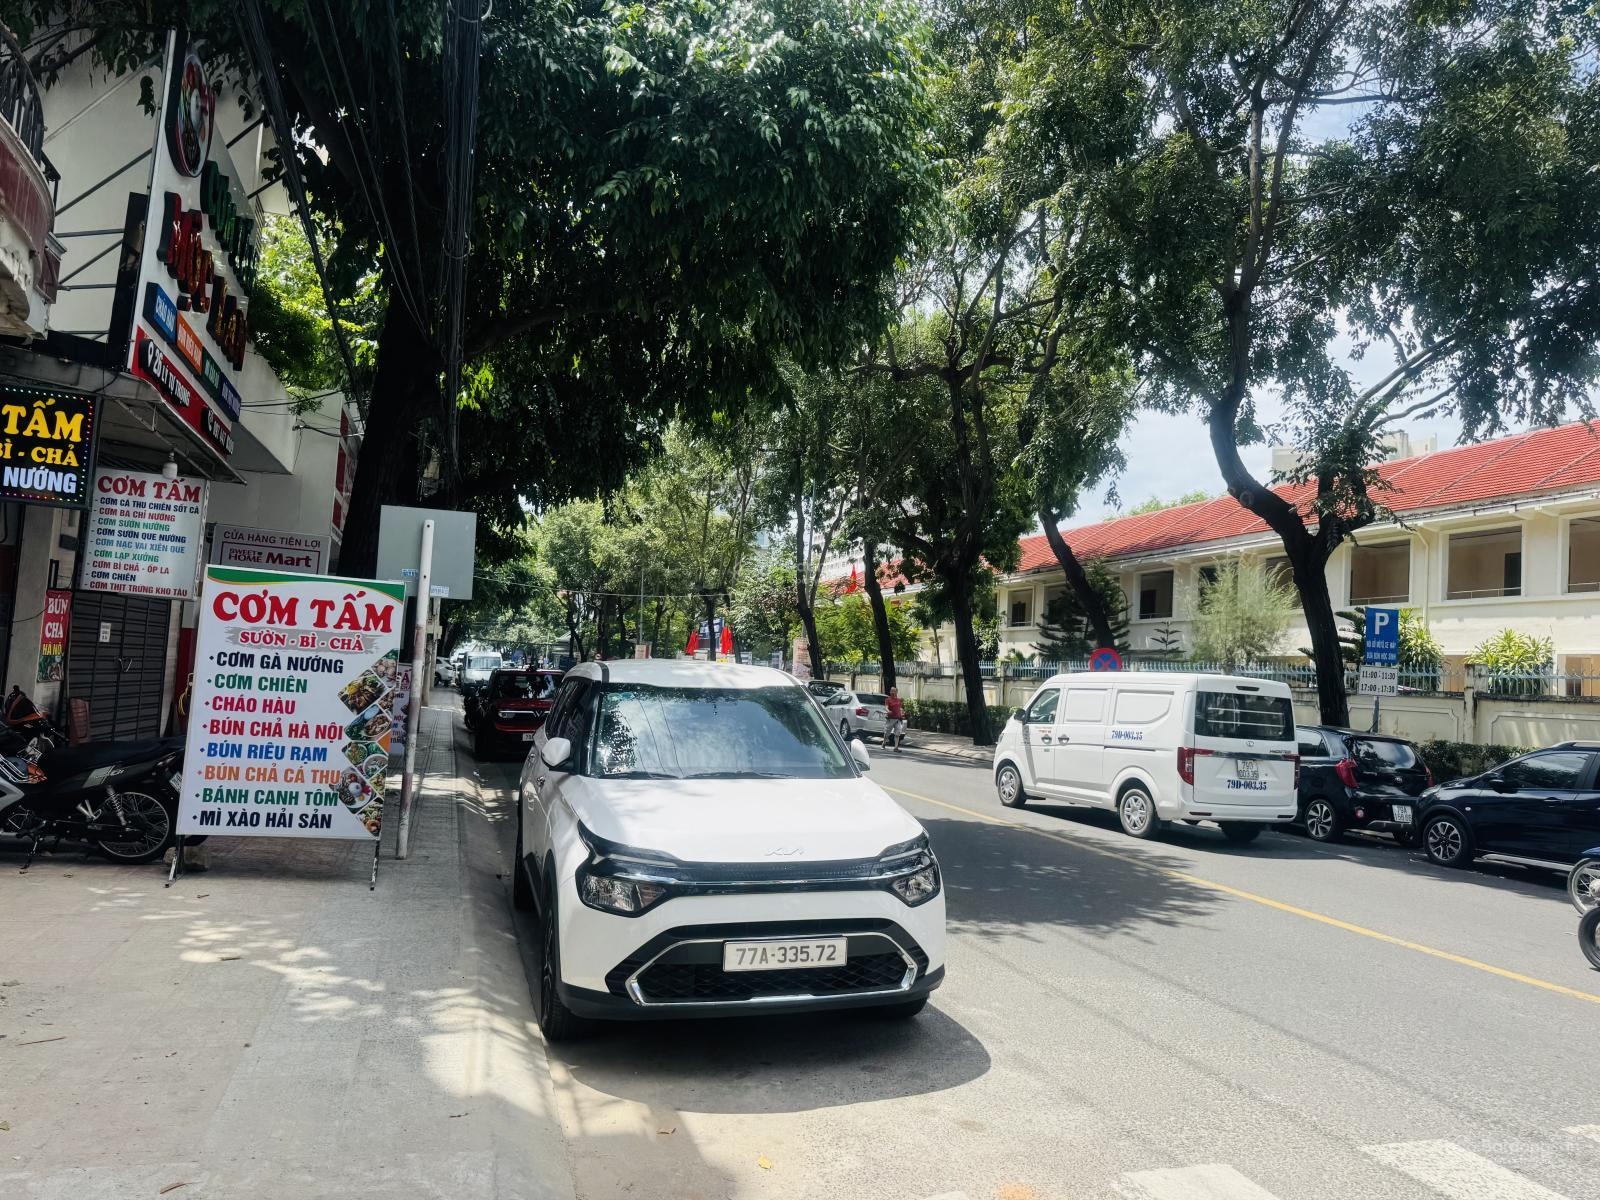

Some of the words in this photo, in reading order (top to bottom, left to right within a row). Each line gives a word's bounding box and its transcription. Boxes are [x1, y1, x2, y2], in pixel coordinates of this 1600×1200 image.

[153, 348, 163, 378] 26
[1, 398, 85, 442] TẤM
[0, 438, 13, 459] Ì
[30, 444, 79, 467] CHẢ
[3, 465, 77, 494] NƯỚNG
[97, 475, 147, 497] CƠM
[152, 478, 201, 503] TẤM
[99, 507, 117, 516] CƠM
[100, 497, 117, 506] CƠM
[132, 500, 147, 509] THU
[98, 517, 116, 526] CƠM
[95, 538, 114, 547] CƠM
[96, 528, 115, 536] CƠM
[141, 532, 156, 541] QUE
[223, 528, 245, 540] CỬA
[247, 533, 276, 544] HÀNG
[94, 549, 112, 558] CƠM
[228, 553, 262, 563] HOME
[265, 552, 312, 568] Mart
[230, 548, 257, 556] SWEET
[91, 570, 110, 579] CƠM
[92, 560, 111, 569] CƠM
[90, 580, 107, 589] CƠM
[47, 594, 69, 614] BÚN
[213, 589, 300, 626] CƠM
[310, 591, 394, 633] TẤM
[1374, 612, 1390, 635] P
[240, 630, 286, 646] SƯỜN
[300, 633, 316, 648] BÌ
[330, 635, 364, 651] CHẢ
[217, 652, 254, 669] CƠM
[260, 652, 284, 670] GÀ
[287, 655, 344, 674] NƯỚNG
[214, 673, 252, 690] CƠM
[257, 674, 308, 693] CHIÊN
[212, 696, 257, 713] CHÁO
[262, 698, 296, 715] HÀU
[209, 717, 245, 736] BÚN
[250, 717, 282, 738] CHẢ
[288, 721, 310, 740] HÀ
[315, 722, 343, 743] NỘI
[207, 740, 242, 759] BÚN
[247, 742, 285, 761] RIÊU
[290, 746, 328, 765] RẠM
[204, 762, 240, 781] BÚN
[245, 762, 278, 783] CHẢ
[283, 764, 305, 784] CÁ
[310, 769, 341, 785] THU
[1227, 780, 1267, 791] 79D-003.35
[202, 785, 249, 804] BÁNH
[254, 789, 299, 806] CANH
[304, 788, 339, 807] TÔM
[199, 807, 221, 827] MÌ
[226, 808, 261, 828] XÀO
[265, 807, 293, 829] HẢI
[298, 808, 332, 829] SẢN
[736, 944, 837, 965] 77A-335.72
